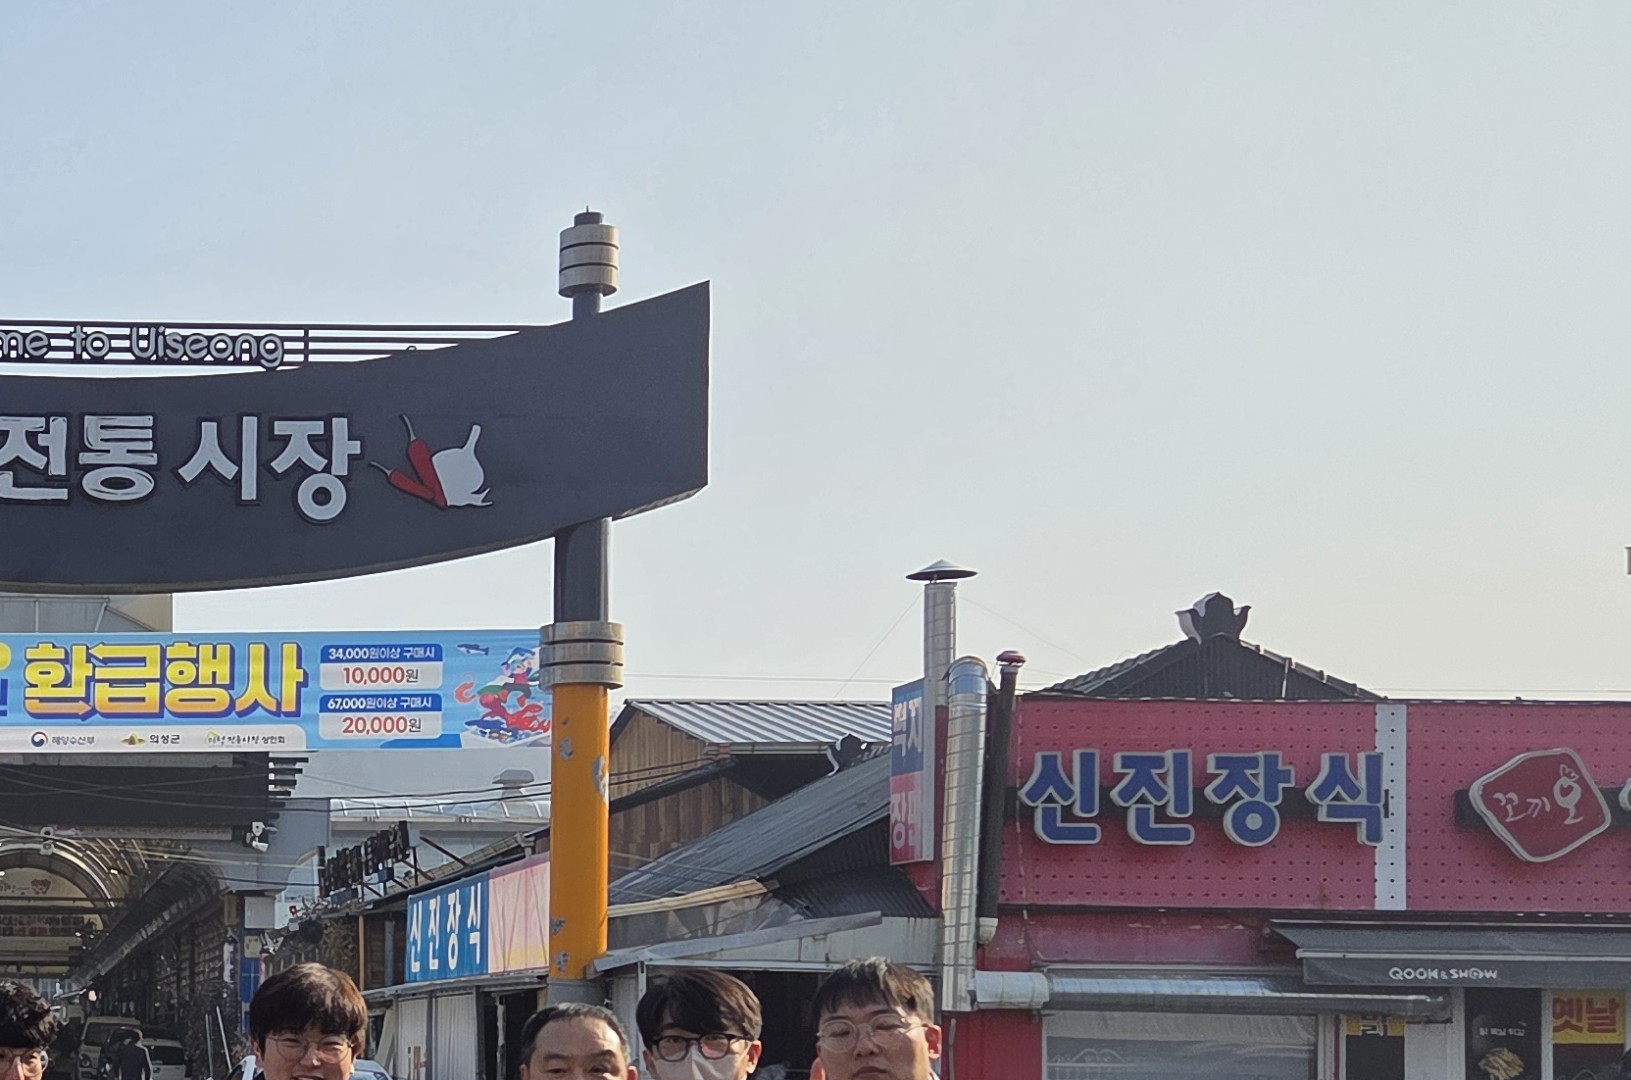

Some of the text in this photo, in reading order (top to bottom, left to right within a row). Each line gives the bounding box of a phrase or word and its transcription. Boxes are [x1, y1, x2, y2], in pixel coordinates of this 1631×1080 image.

[70, 324, 110, 358] to
[129, 326, 285, 371] Uiseong
[403, 646, 435, 659] 구매시
[24, 642, 304, 714] 환급행사
[343, 666, 419, 685] 10,000원
[400, 696, 432, 709] 구매시
[149, 733, 181, 745] 의성군
[342, 716, 421, 734] 20,000원
[1020, 748, 1386, 847] 신진장식
[409, 880, 482, 975] 신진장식
[1552, 997, 1620, 1035] 옛날
